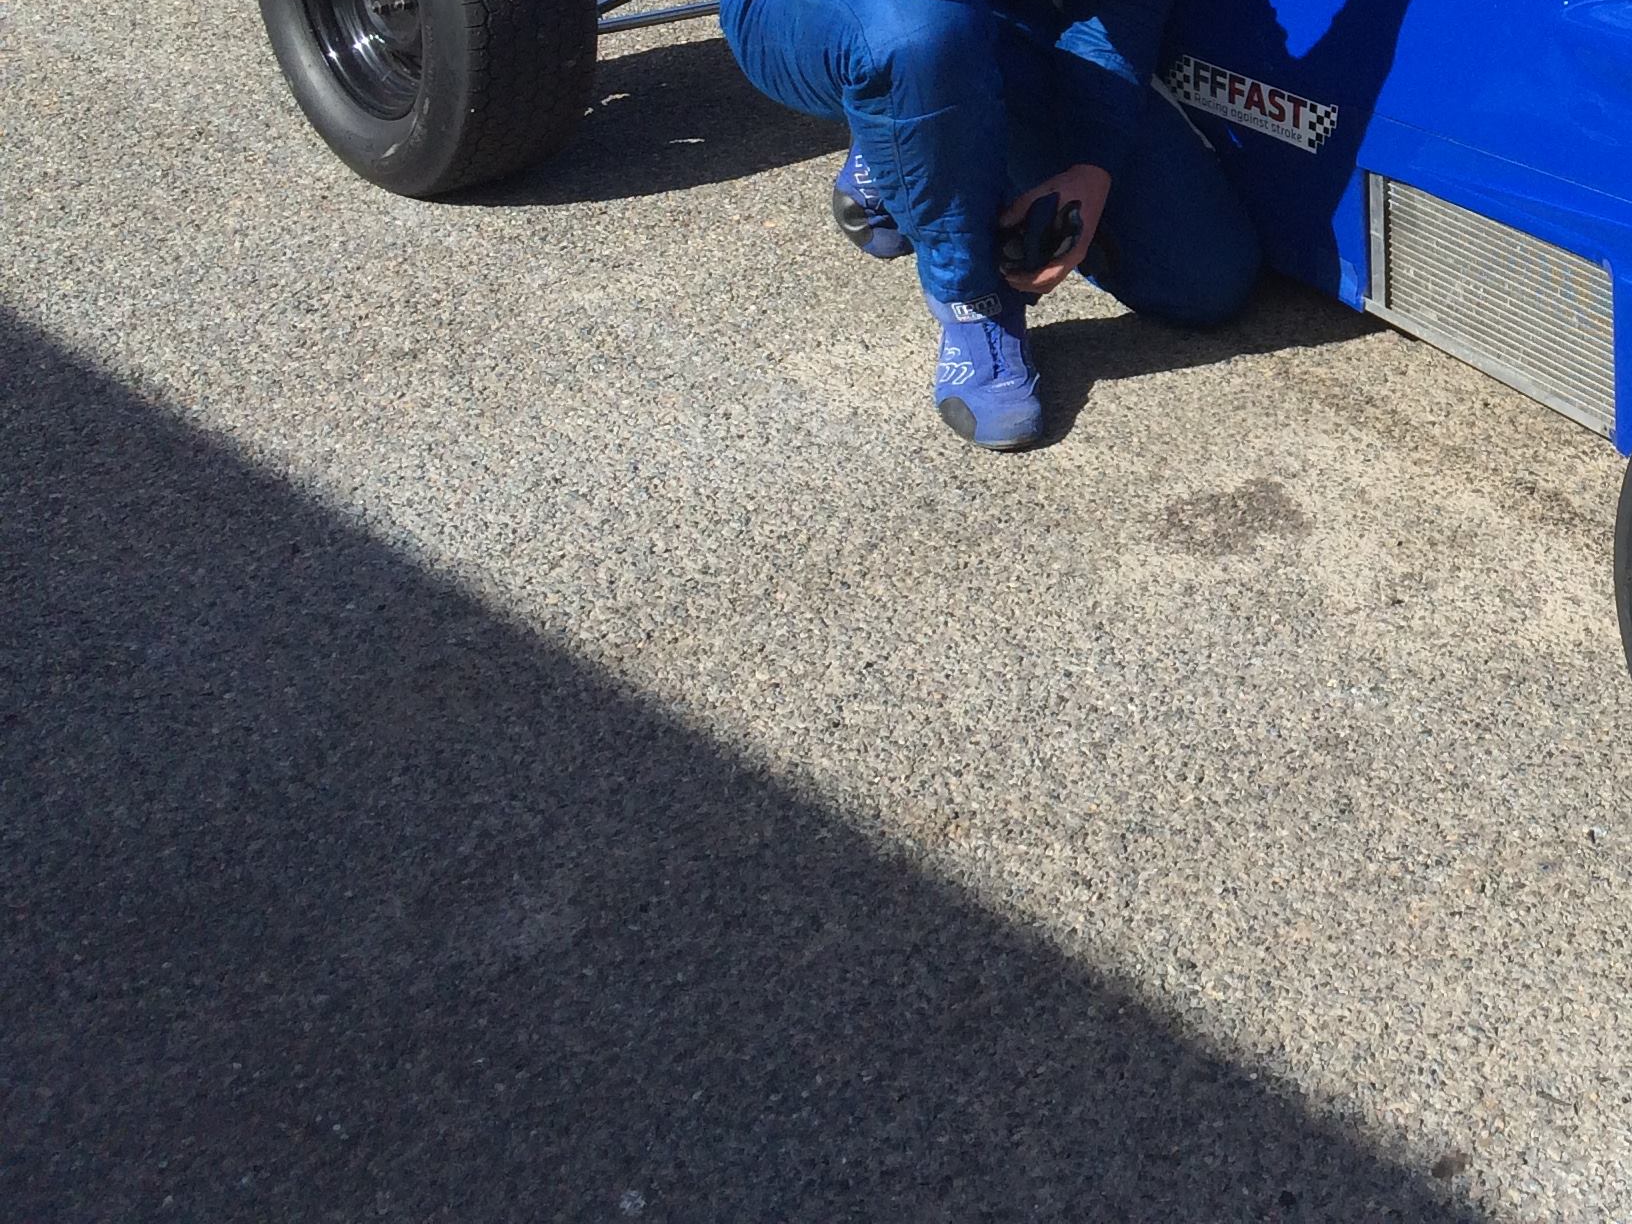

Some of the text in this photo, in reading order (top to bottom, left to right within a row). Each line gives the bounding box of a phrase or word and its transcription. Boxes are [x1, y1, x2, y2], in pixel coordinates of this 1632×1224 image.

[1193, 60, 1308, 130] FFFAST
[1193, 92, 1303, 143] Racing against stroke
